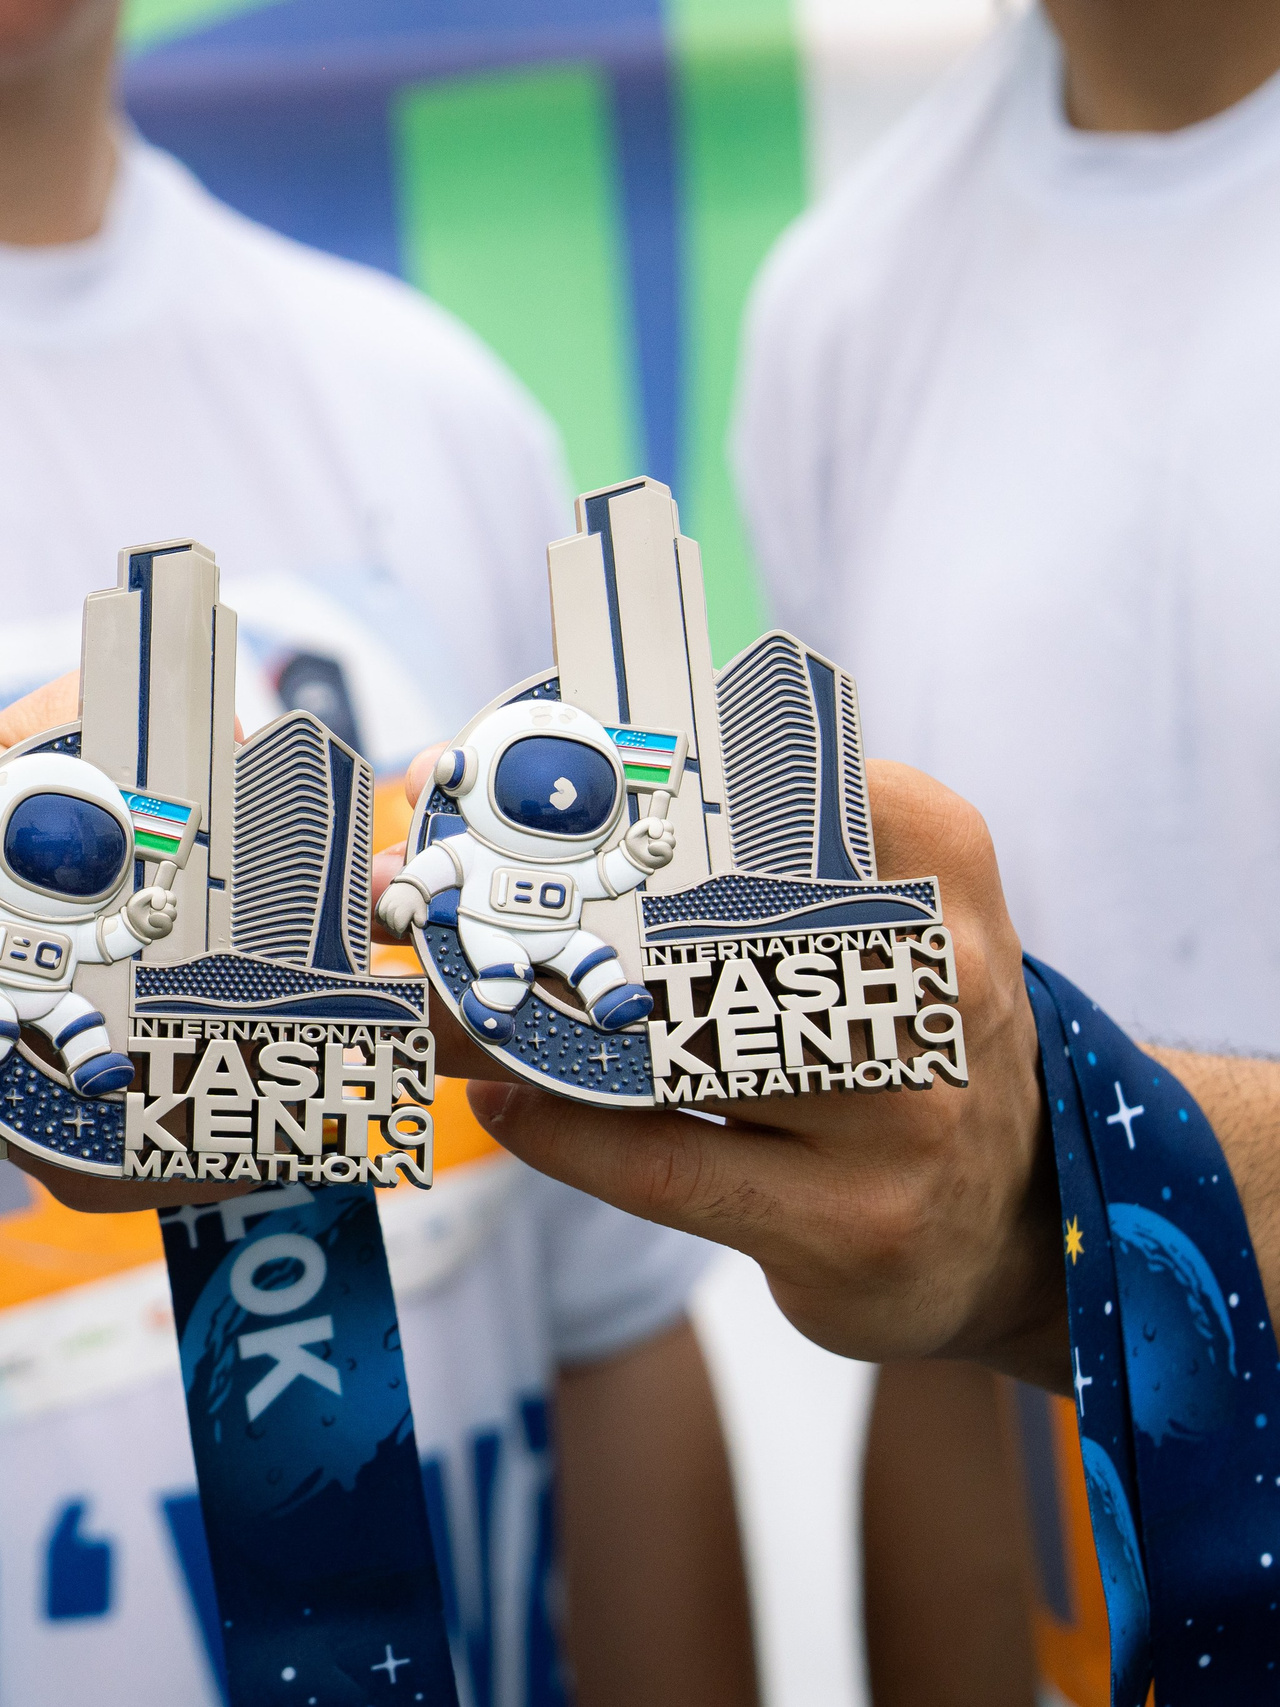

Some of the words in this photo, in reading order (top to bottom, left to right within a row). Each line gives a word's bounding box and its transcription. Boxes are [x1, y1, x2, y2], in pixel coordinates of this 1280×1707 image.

[642, 929, 910, 966] INTERNATIONAL
[643, 946, 917, 1022] TASH
[912, 926, 968, 1087] 2026
[129, 1018, 391, 1047] INTERNATIONAL
[649, 1003, 917, 1077] KENT
[129, 1037, 392, 1101] TASH
[654, 1058, 926, 1103] MARATHON
[125, 1092, 391, 1156] KENT
[387, 1028, 435, 1190] 2026
[124, 1150, 392, 1184] MARATHON
